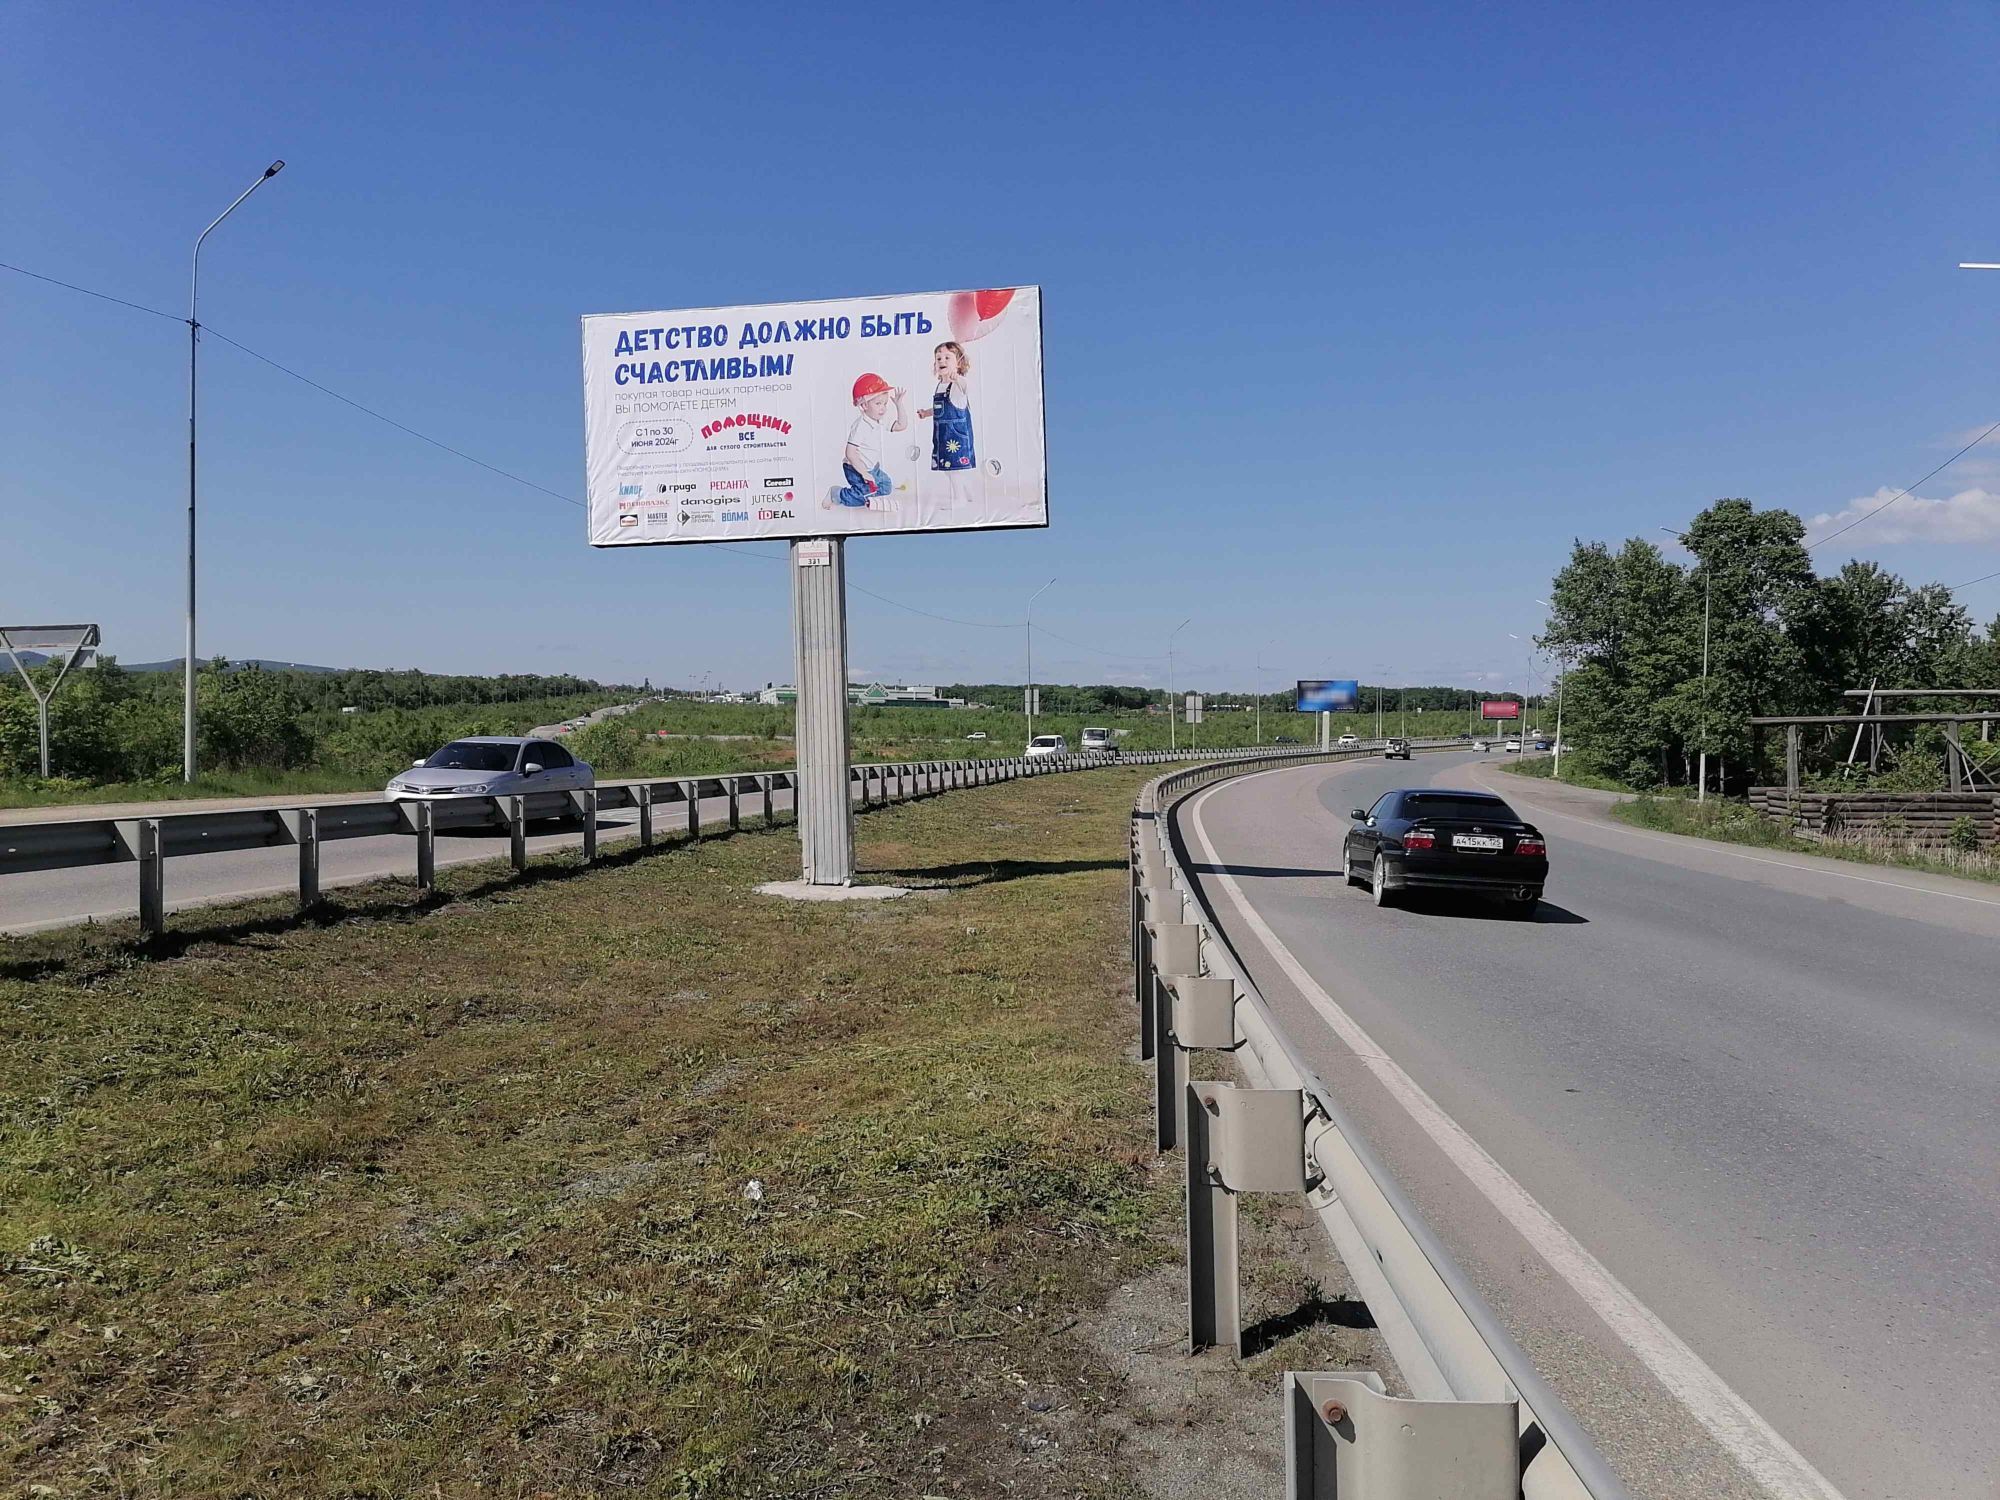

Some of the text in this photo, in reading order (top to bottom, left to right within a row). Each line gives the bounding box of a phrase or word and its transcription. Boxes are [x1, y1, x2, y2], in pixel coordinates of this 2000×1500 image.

[614, 312, 932, 357] ДЕТСТВО ДОЛЖНО БЫТЬ
[614, 354, 794, 385] СЧАСТЛИВЫМ!
[615, 383, 792, 401] покупая товар наших партнеров
[615, 397, 737, 414] ВЫ ПОМОГАЕТЕ ДЕТЯМ
[644, 428, 648, 436] 1
[662, 427, 674, 435] 30
[700, 413, 792, 439] ПОМОЩНИК
[631, 437, 679, 448] июня 2024г
[738, 431, 755, 441] ВСЕ
[710, 479, 749, 491] РЕСАНТА
[680, 495, 741, 506] danogips
[752, 493, 783, 506] JUTEKS
